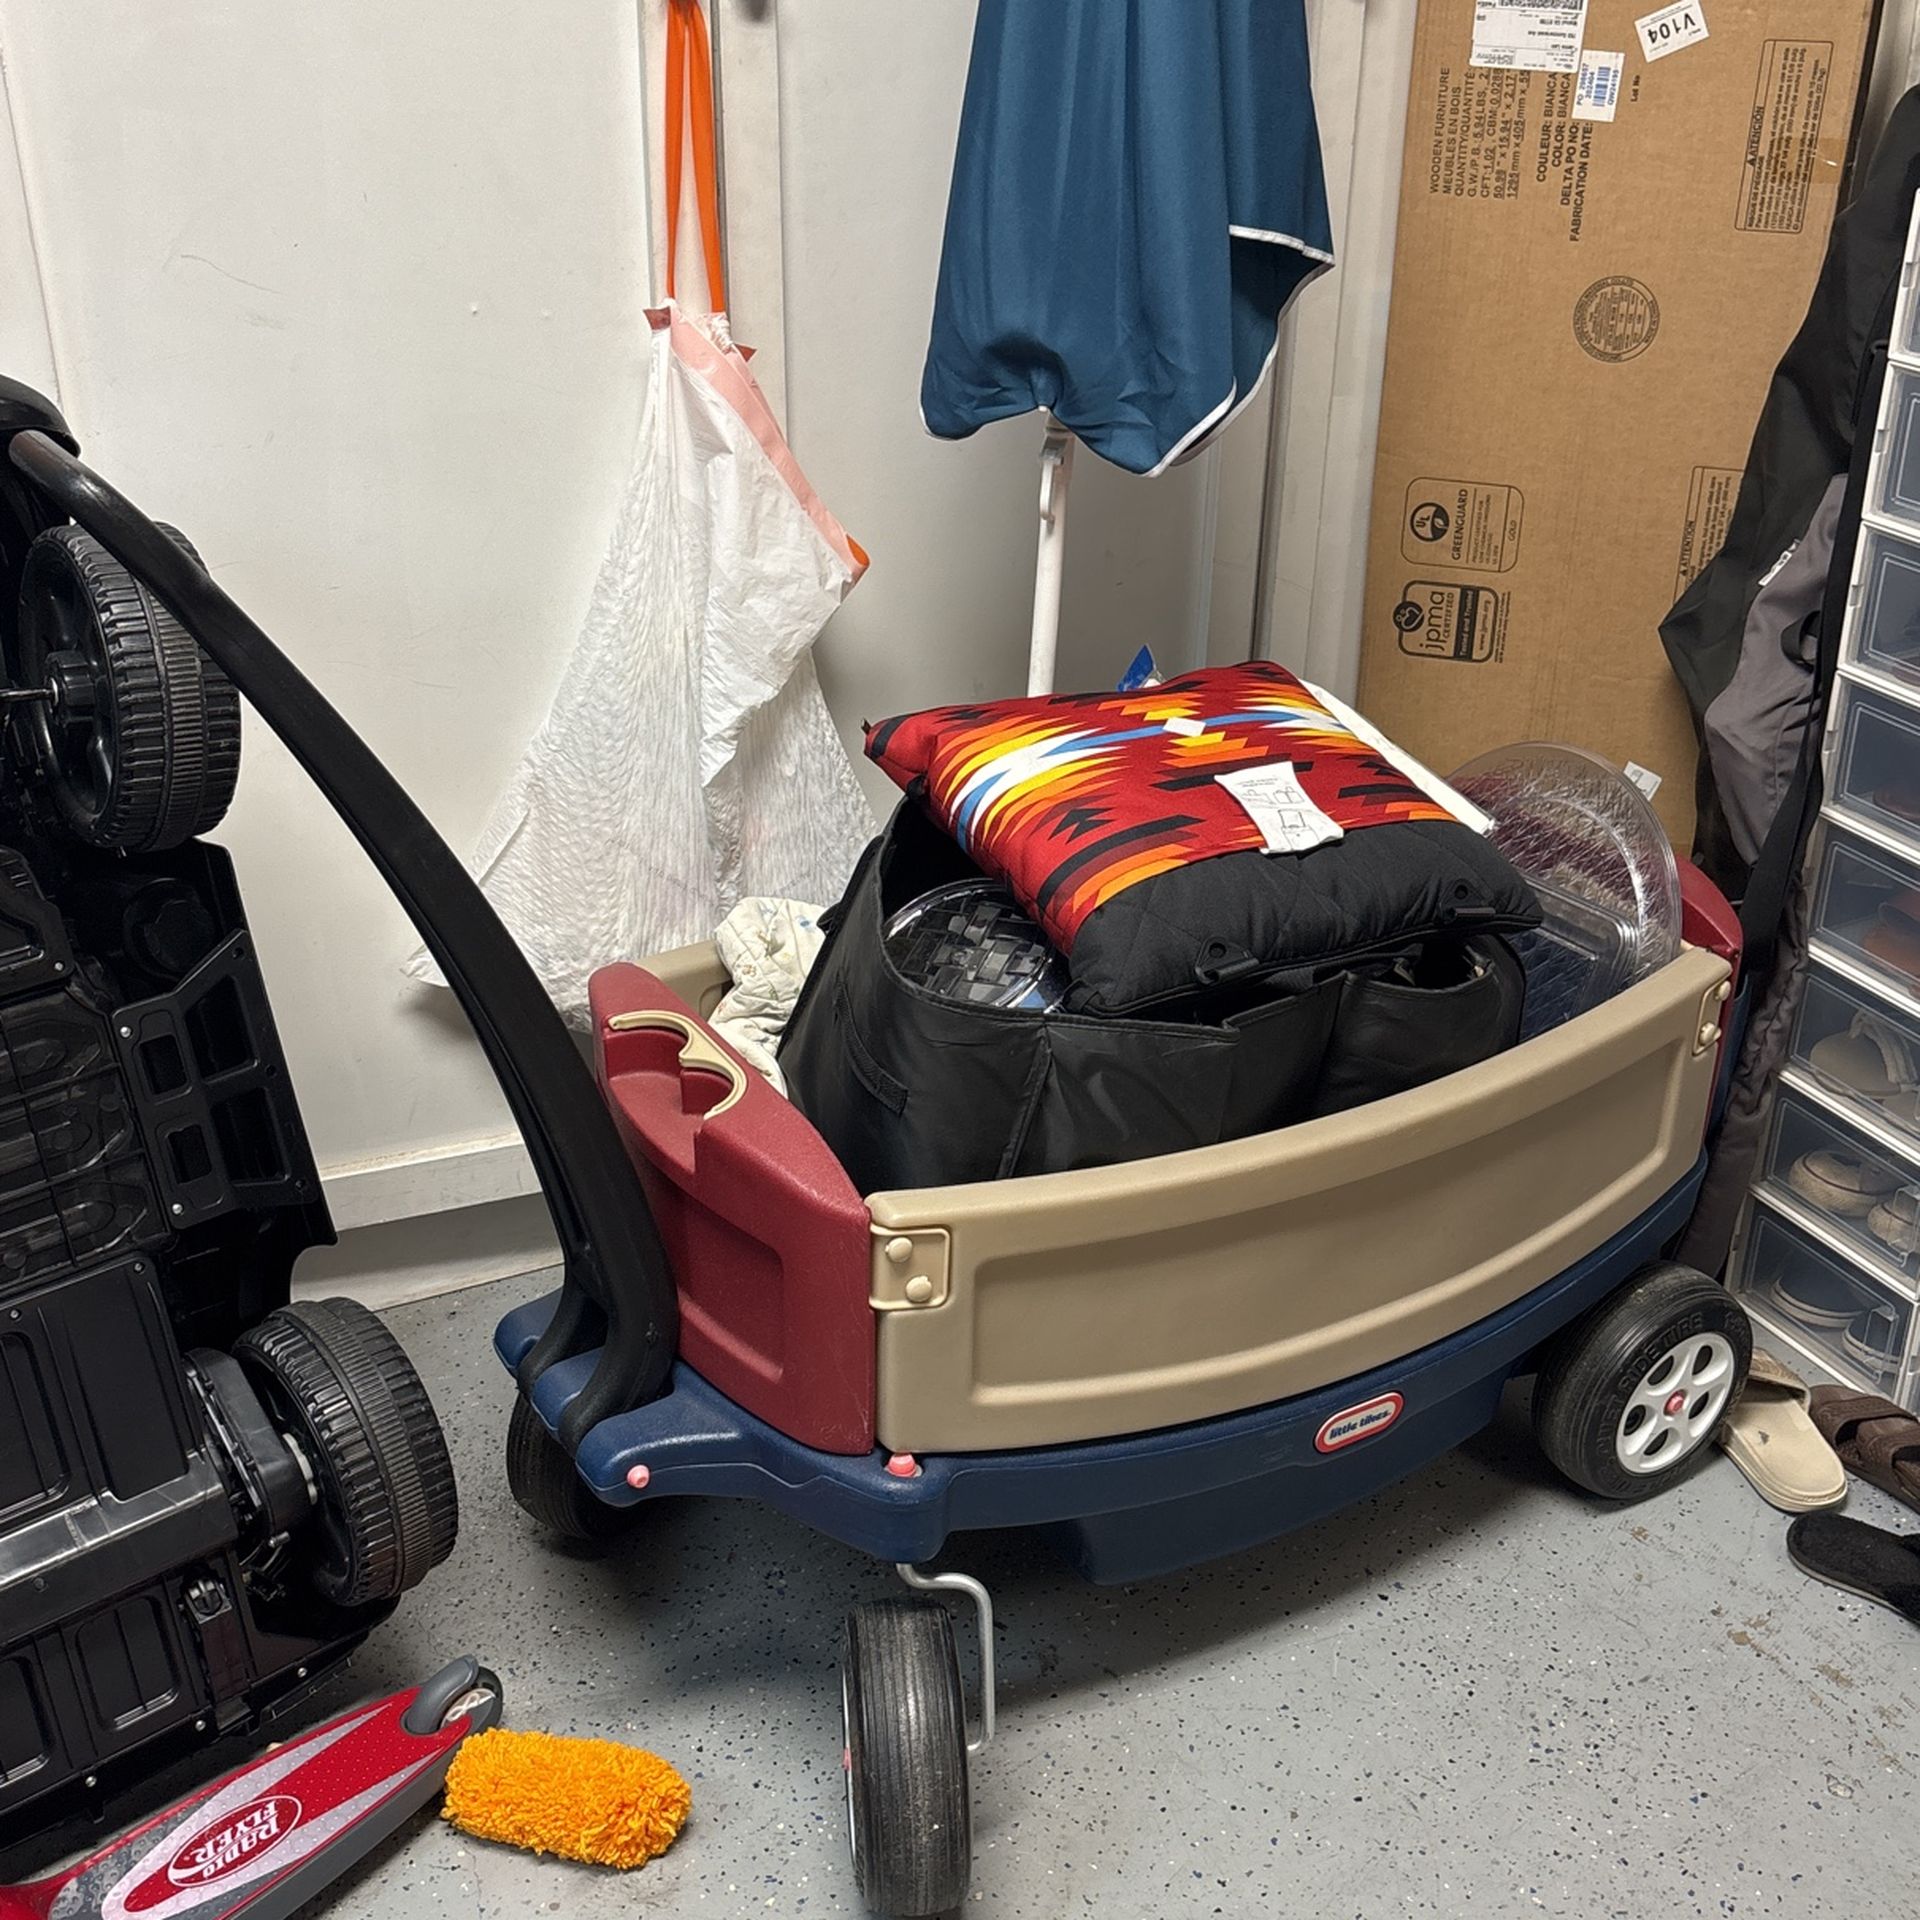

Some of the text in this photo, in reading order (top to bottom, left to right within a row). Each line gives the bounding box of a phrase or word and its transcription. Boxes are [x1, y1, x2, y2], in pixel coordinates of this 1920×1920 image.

[1648, 13, 1696, 44] V104
[1557, 72, 1571, 117] BIANCA
[1576, 93, 1583, 105] PO
[1429, 67, 1449, 193] WOODEN FURNITURE
[1442, 86, 1461, 194] MEUBLES EN BOIS
[1536, 71, 1557, 182] COULEUR: BIANCA
[1551, 121, 1566, 167] COLOR:
[1747, 105, 1765, 156] ATENCIÓN
[1560, 122, 1579, 205] DELTA PO NO:
[1569, 122, 1593, 241] FABRICATION DATE:
[1415, 515, 1429, 528] UL
[1451, 488, 1468, 560] GREENGUARD
[1507, 519, 1517, 541] GOLD
[1680, 520, 1694, 566] ATTENTION
[1418, 590, 1454, 651] jpma
[1440, 591, 1456, 638] CERTIFIED
[1459, 590, 1474, 655] Tested and Trusted
[1618, 1345, 1661, 1392] RIDE
[1657, 1311, 1705, 1350] TIRE
[1329, 1422, 1358, 1440] little
[189, 1800, 279, 1863] FLYER
[203, 1813, 281, 1878] RADIO
